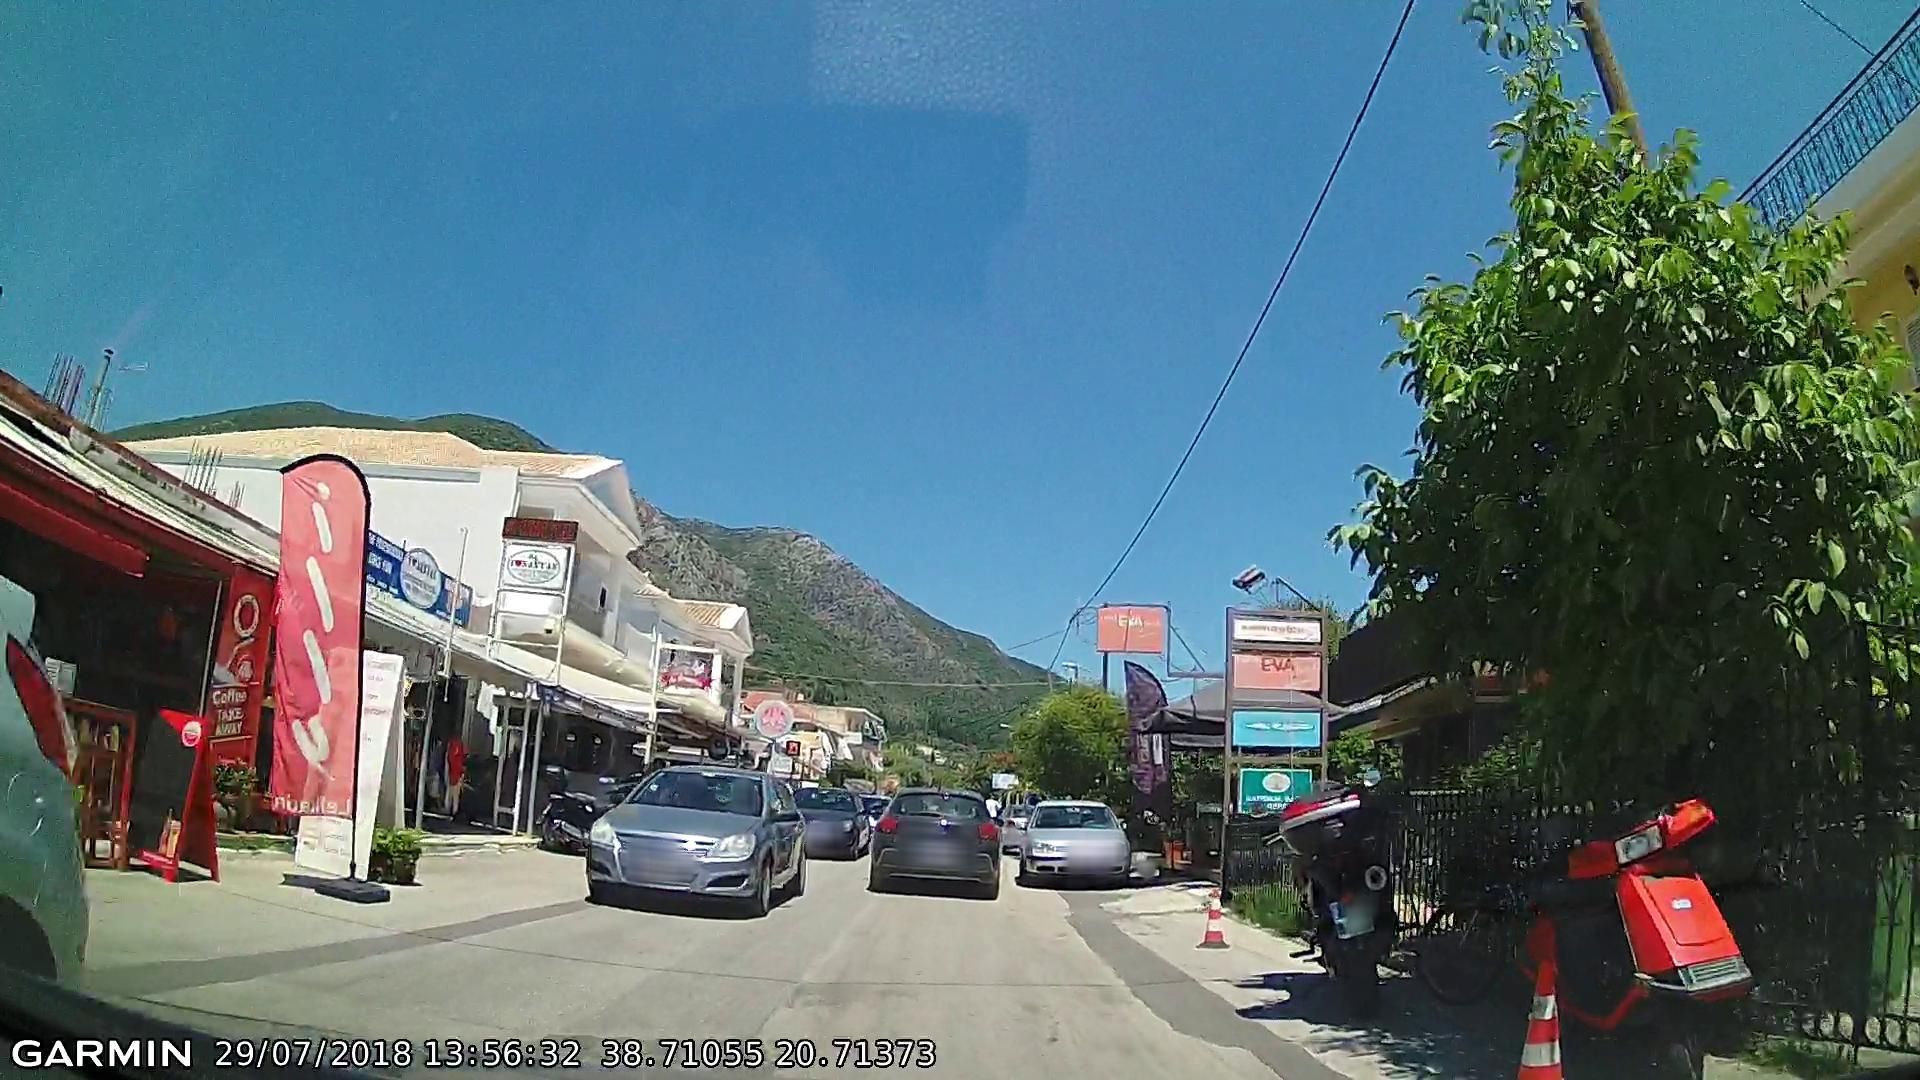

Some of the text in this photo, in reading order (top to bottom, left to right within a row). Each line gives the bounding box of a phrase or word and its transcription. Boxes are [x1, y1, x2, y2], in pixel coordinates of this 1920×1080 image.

[1261, 657, 1294, 673] EVA
[212, 688, 247, 705] Coffee
[217, 707, 244, 722] TAKE
[215, 721, 243, 736] AWAY
